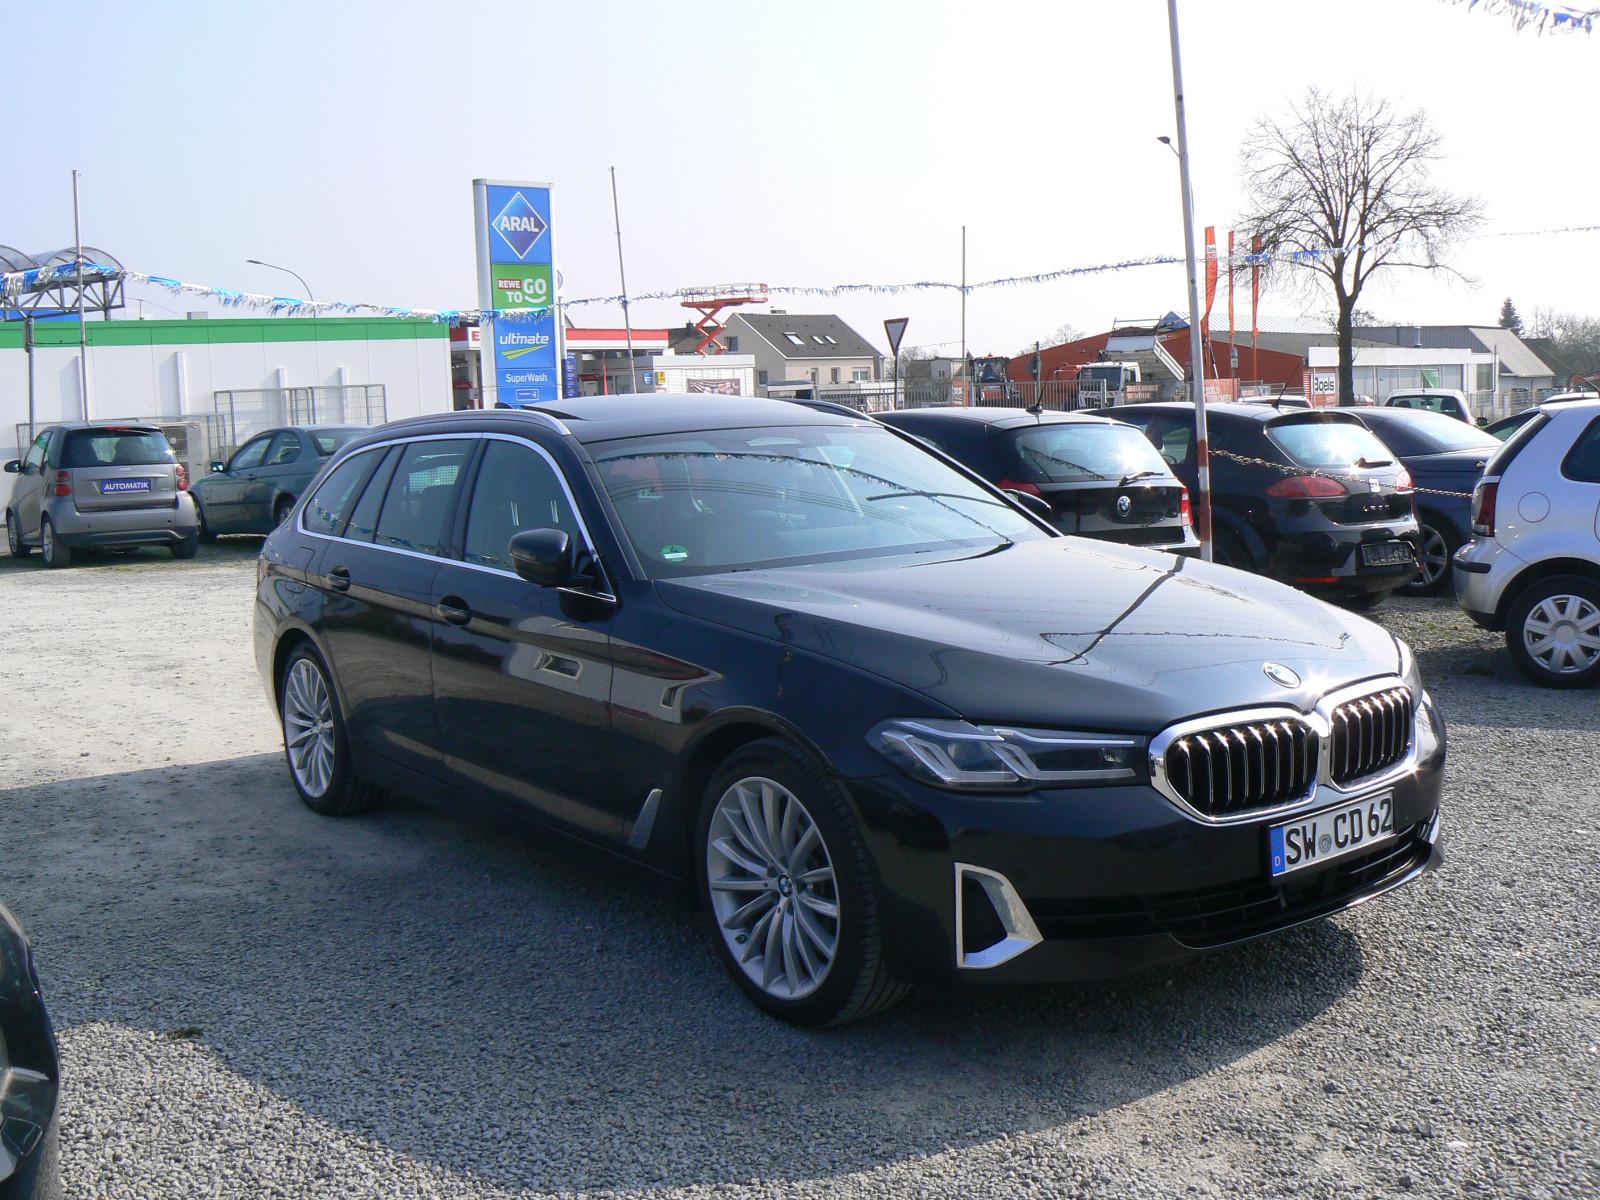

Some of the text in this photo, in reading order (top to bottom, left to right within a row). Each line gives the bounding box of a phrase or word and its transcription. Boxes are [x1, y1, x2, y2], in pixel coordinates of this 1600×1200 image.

[500, 215, 540, 233] ARAL
[498, 279, 521, 289] REWE
[523, 278, 547, 295] GO
[506, 291, 523, 303] TO
[500, 332, 549, 345] ultimate
[505, 372, 548, 385] SuperWash
[104, 481, 149, 491] AUTOMATIK
[1285, 798, 1392, 865] SW CD 62
